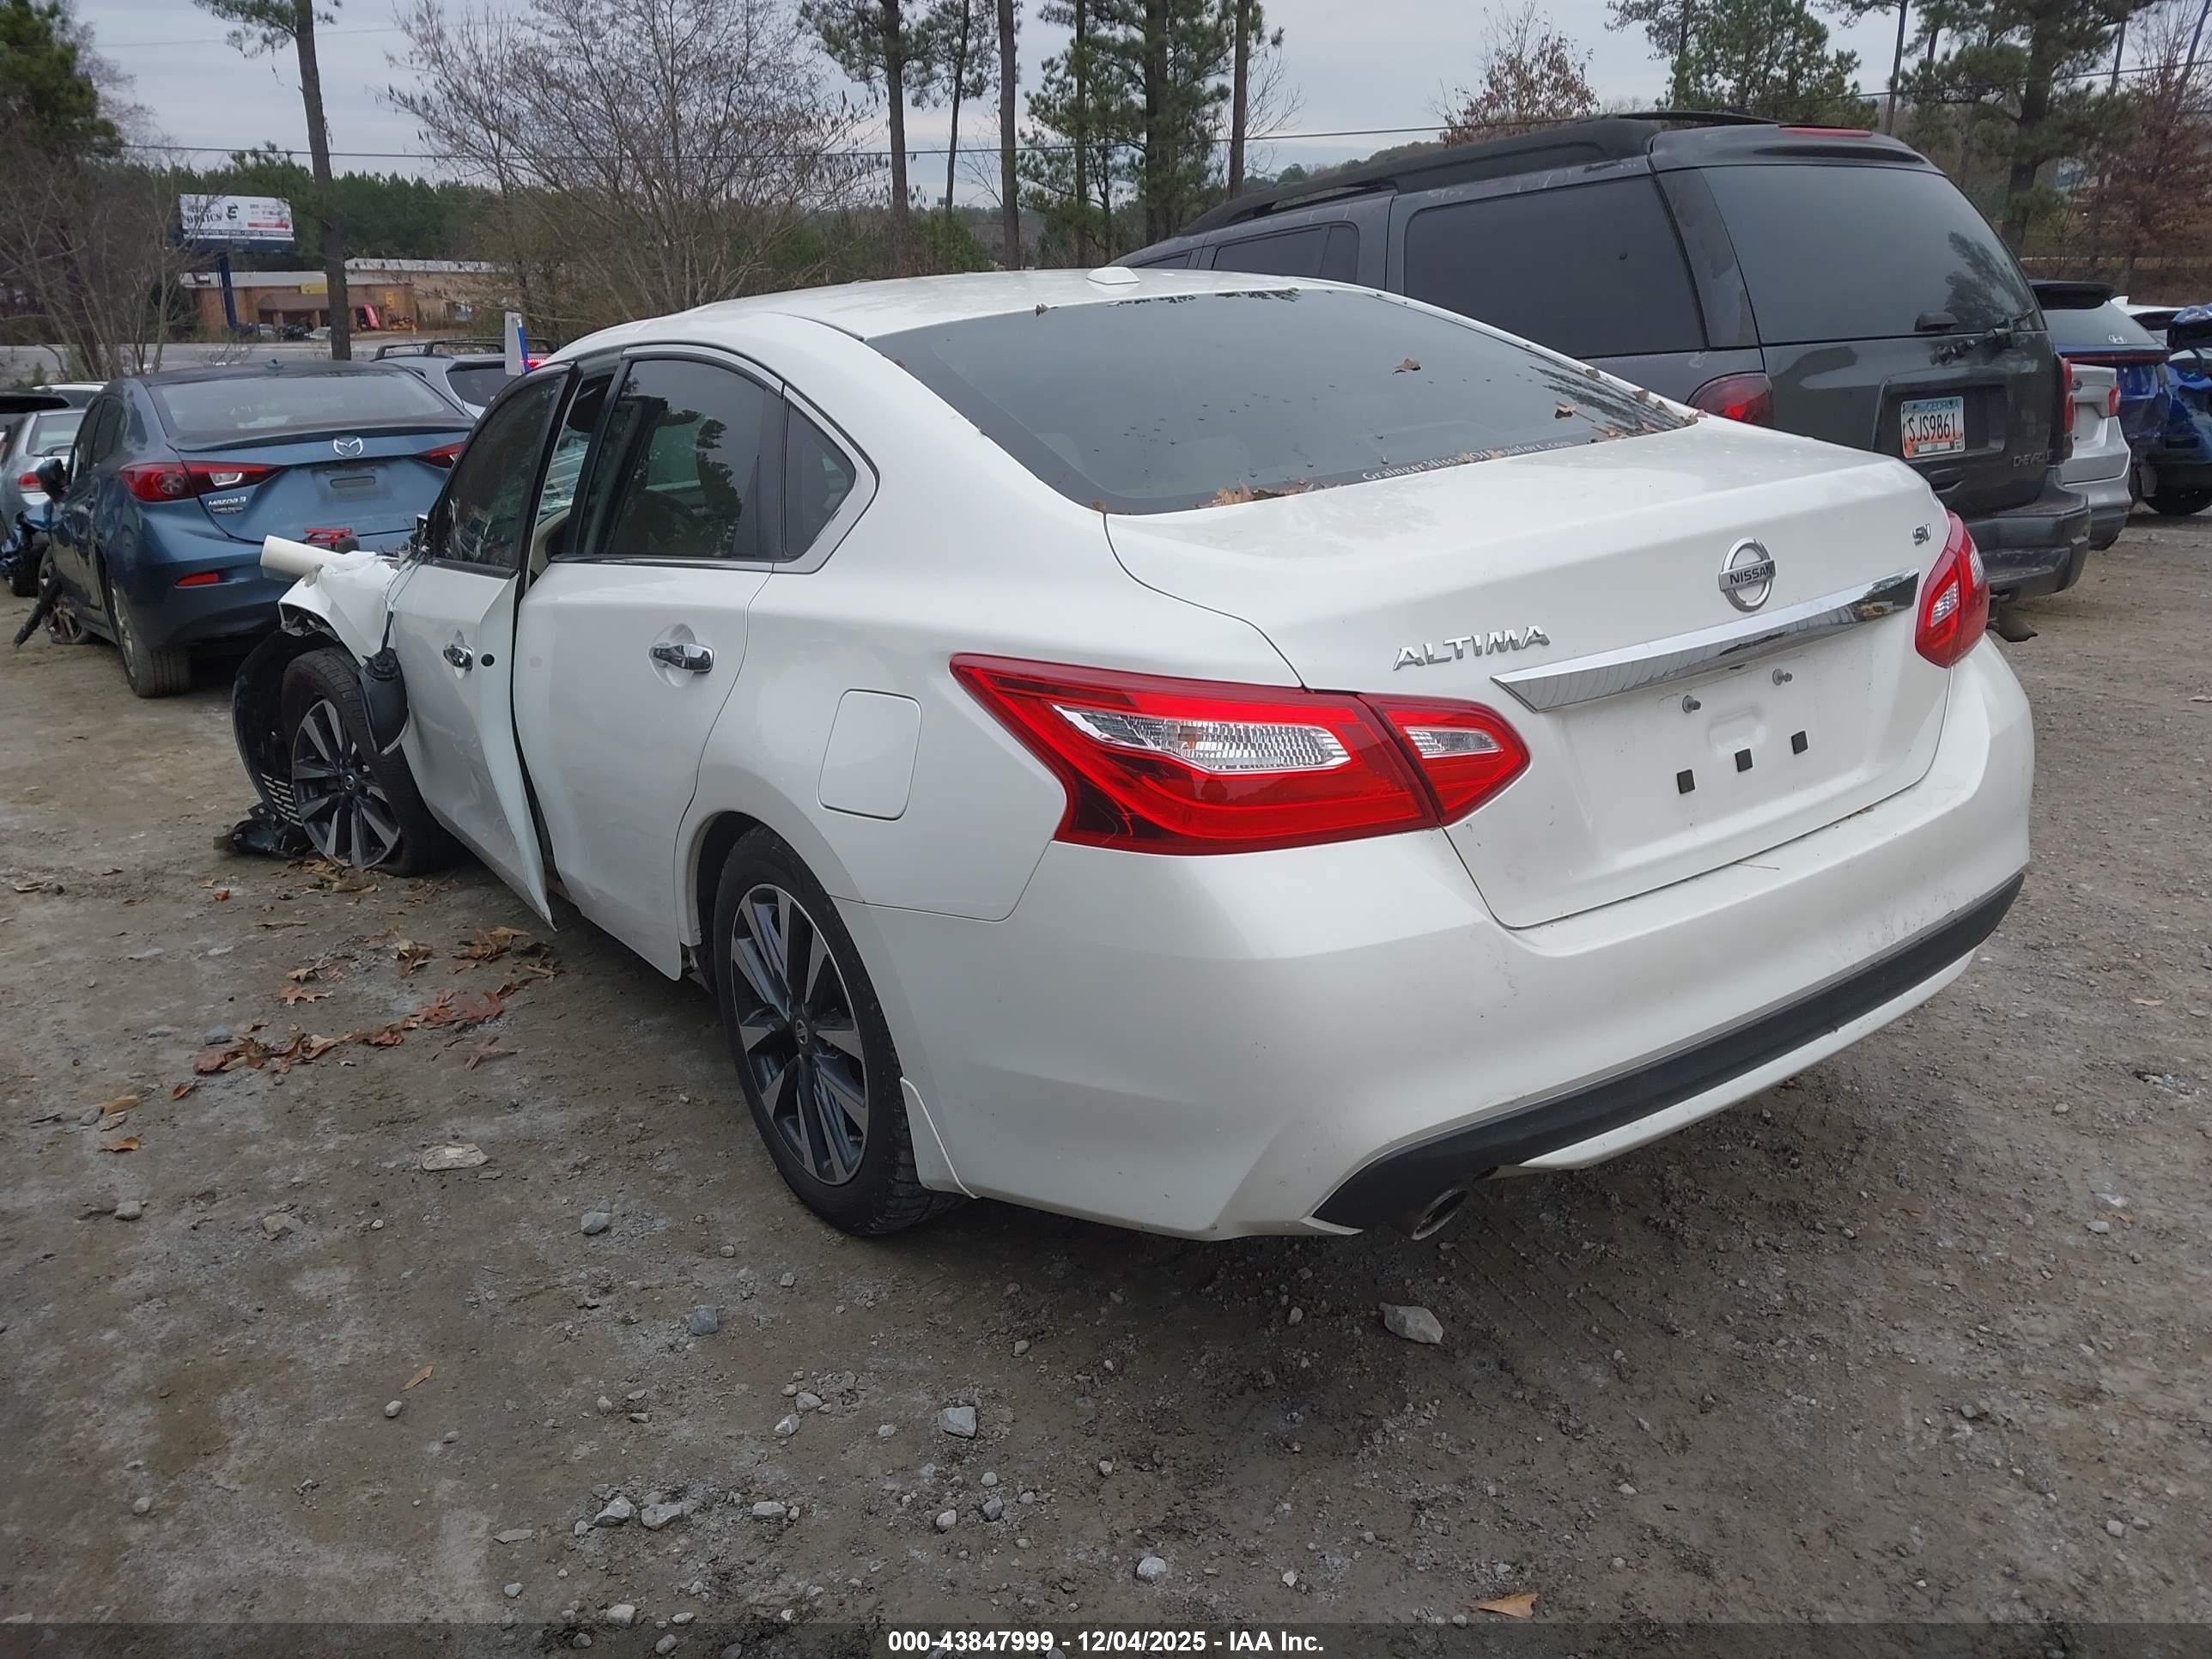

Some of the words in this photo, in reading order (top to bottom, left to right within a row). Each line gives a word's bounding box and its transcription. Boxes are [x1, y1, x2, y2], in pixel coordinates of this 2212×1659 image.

[1908, 411, 1956, 442] SJS9861
[1911, 522, 1931, 547] SV
[1729, 564, 1773, 585] NISSAN
[1393, 624, 1551, 672] ALTIMA
